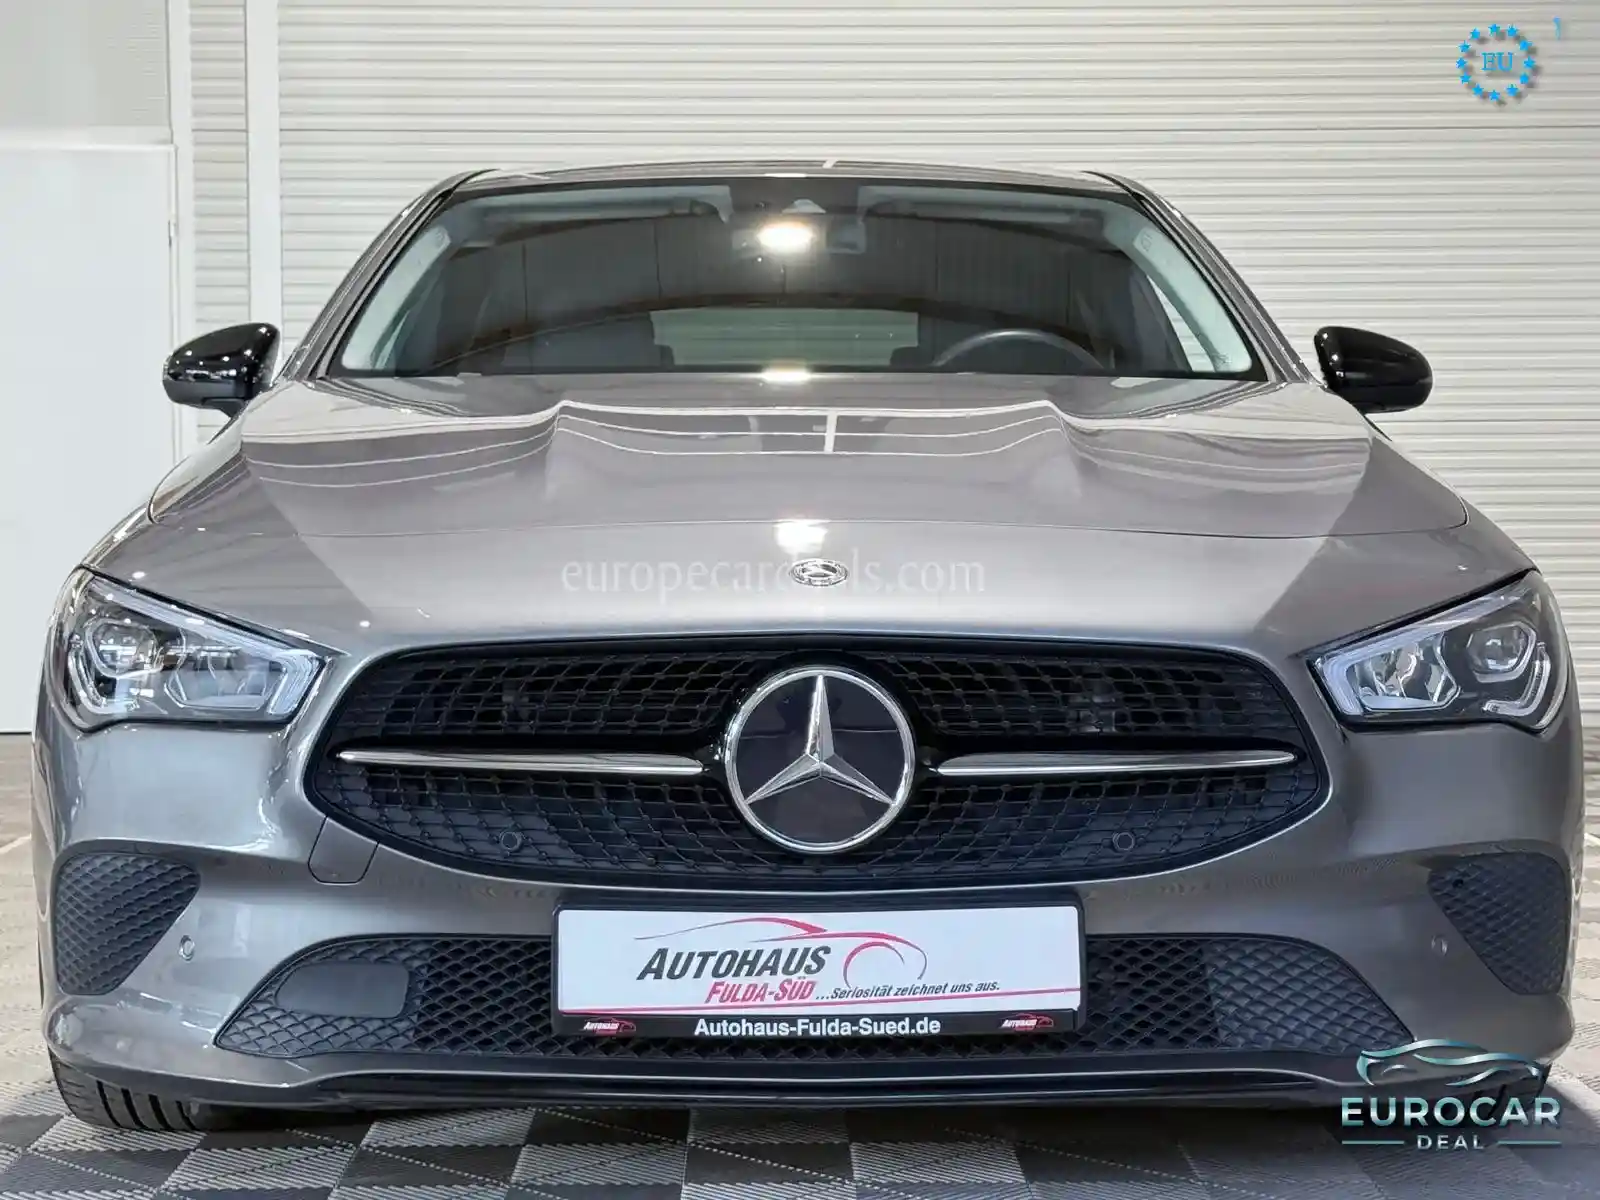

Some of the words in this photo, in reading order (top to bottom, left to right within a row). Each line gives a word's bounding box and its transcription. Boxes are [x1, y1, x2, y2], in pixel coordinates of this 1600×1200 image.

[636, 945, 831, 980] AUTOHAUS
[705, 976, 816, 1003] FULDA-SÜD
[893, 982, 949, 997] zeichnet
[950, 983, 973, 993] uns
[976, 980, 1000, 992] aus.
[694, 1017, 941, 1036] Autohaus-Fulda-Sued.de
